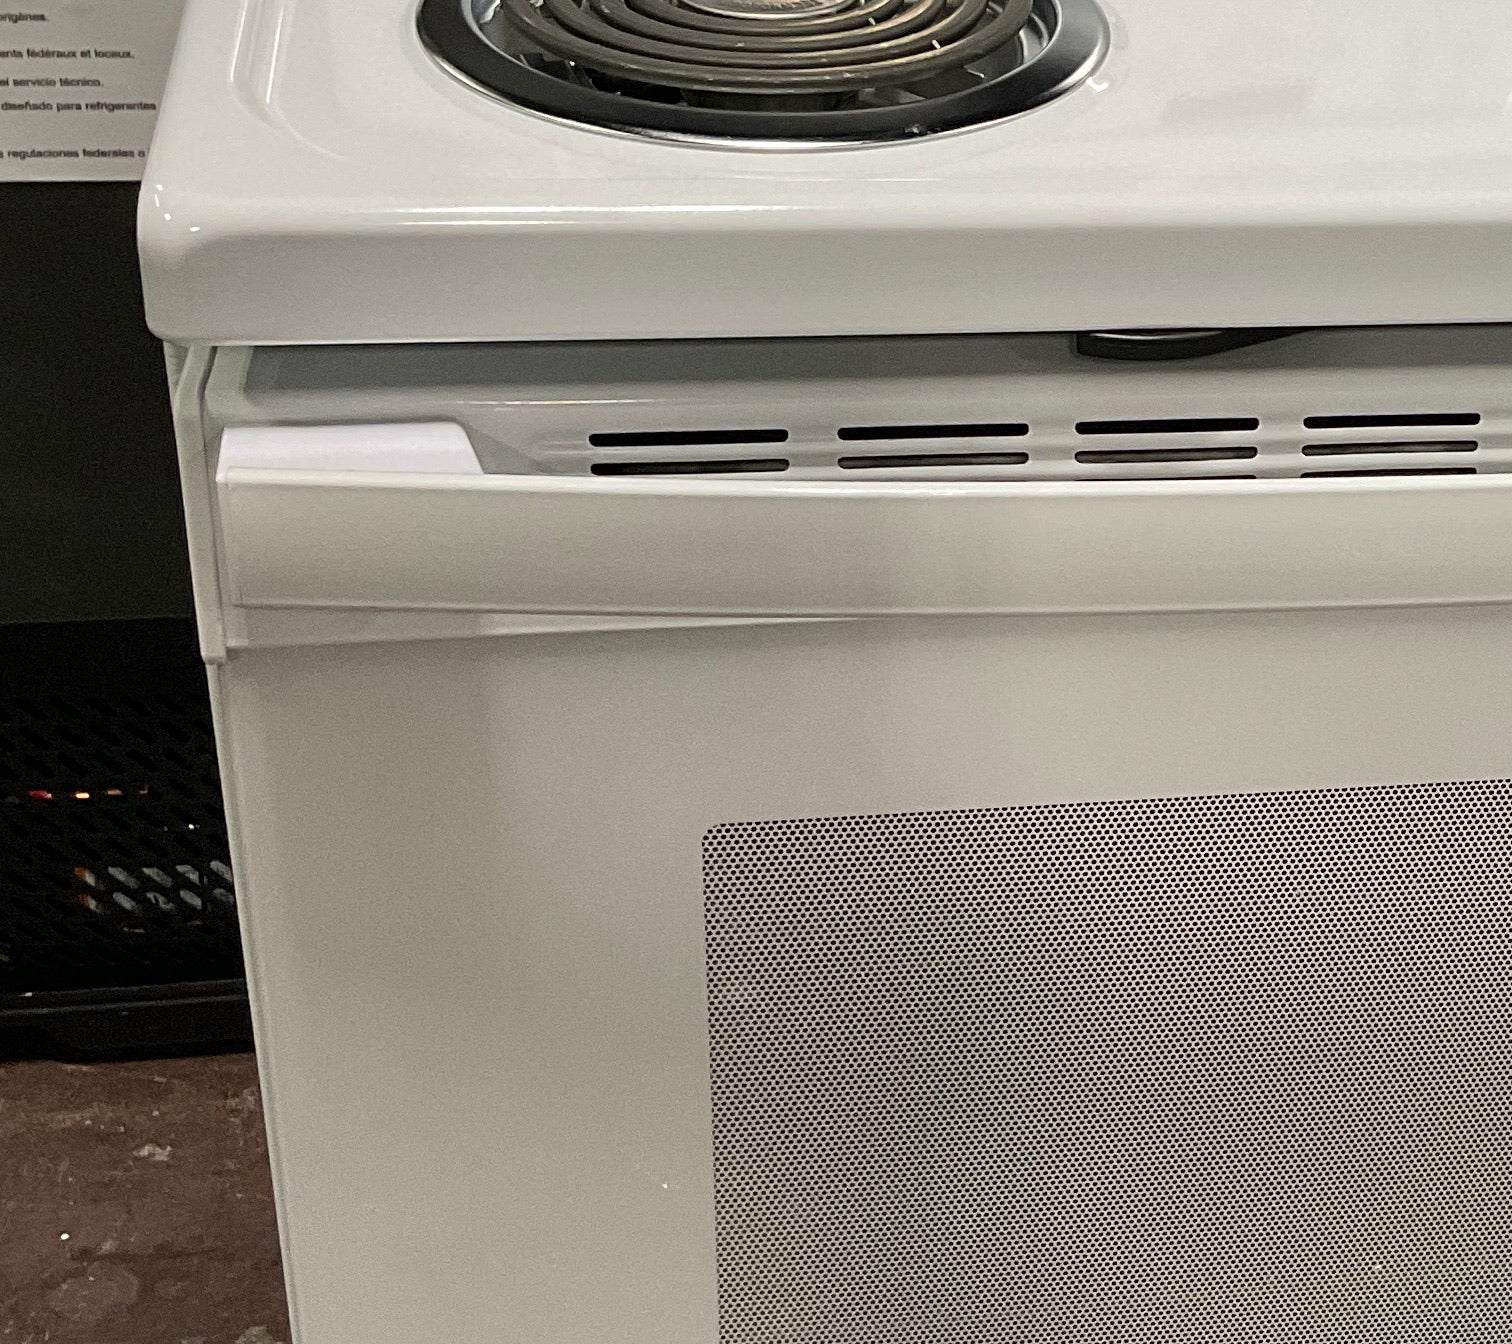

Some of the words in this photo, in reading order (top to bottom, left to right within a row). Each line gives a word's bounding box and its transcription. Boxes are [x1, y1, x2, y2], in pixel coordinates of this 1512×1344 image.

[80, 48, 91, 59] et
[12, 77, 56, 87] servicio
[59, 77, 104, 87] técnico.
[1, 99, 53, 111] diseñado
[56, 101, 82, 113] para
[85, 100, 157, 113] refrigerantes
[7, 148, 79, 161] regulaciones
[82, 147, 135, 158] federales
